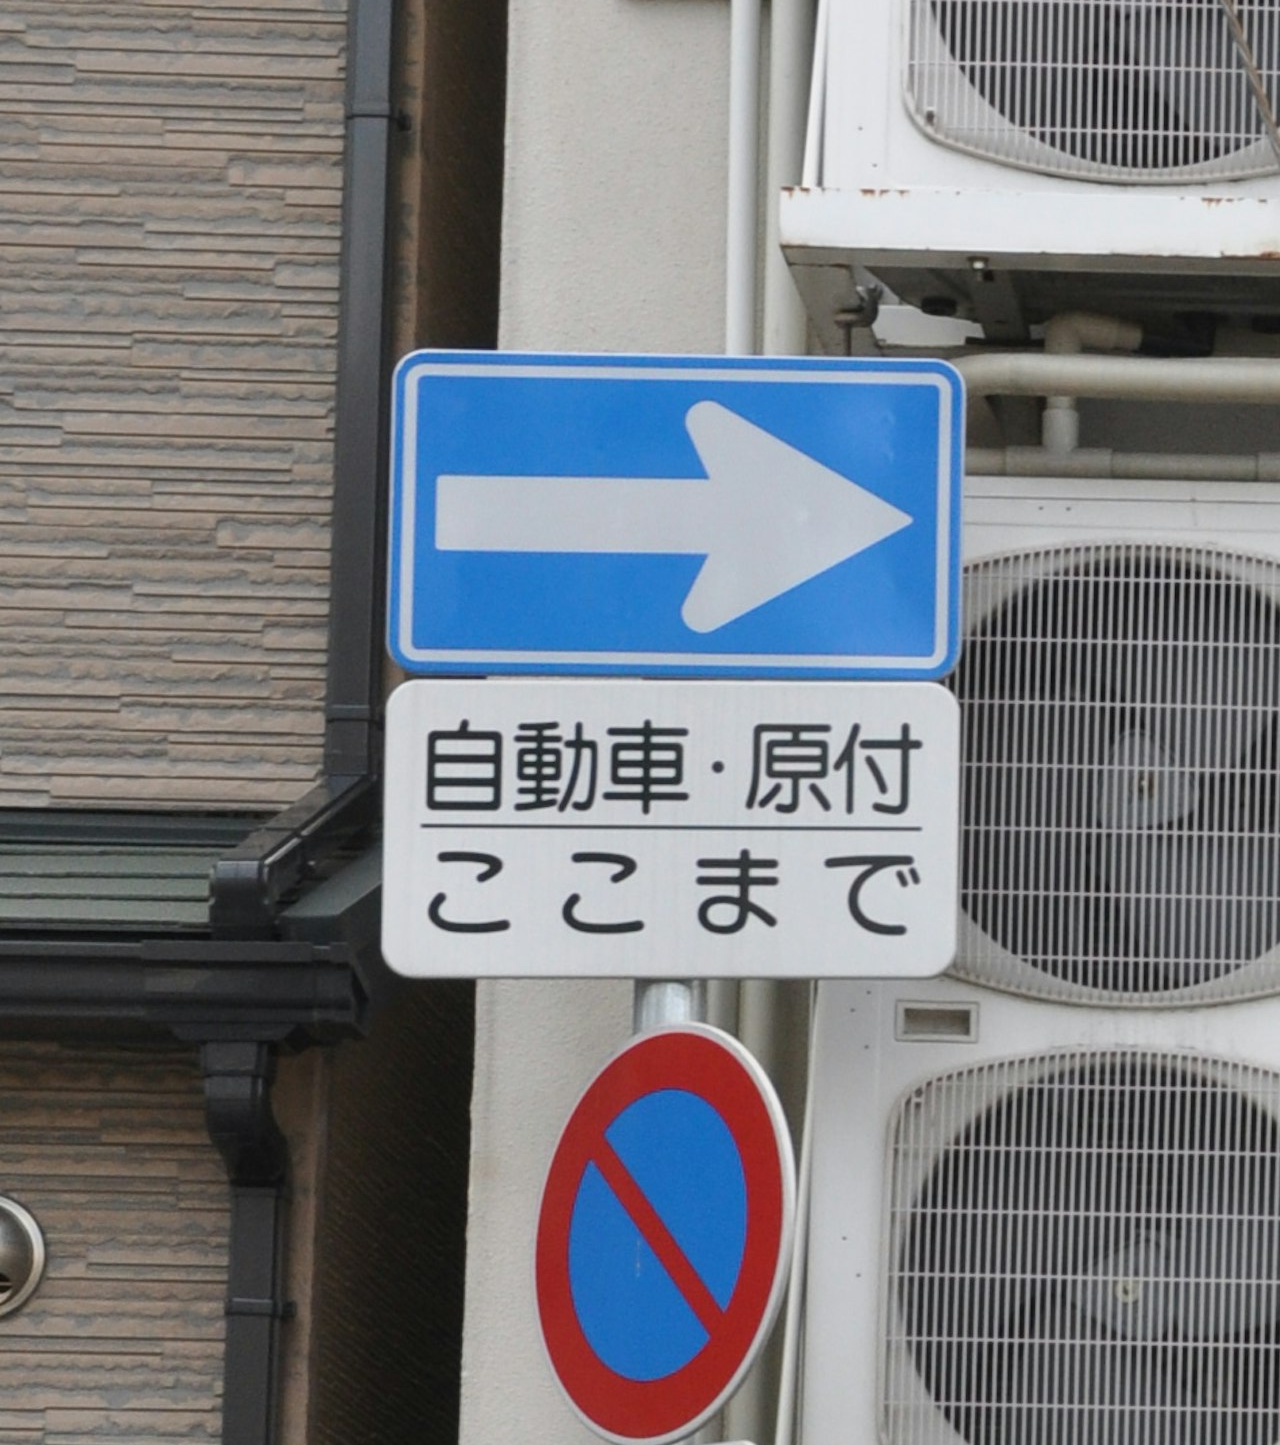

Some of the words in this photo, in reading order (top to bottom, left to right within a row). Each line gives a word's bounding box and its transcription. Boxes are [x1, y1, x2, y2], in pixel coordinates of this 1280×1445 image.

[426, 719, 923, 815] 自動車・原付
[427, 849, 920, 936] ここまで
